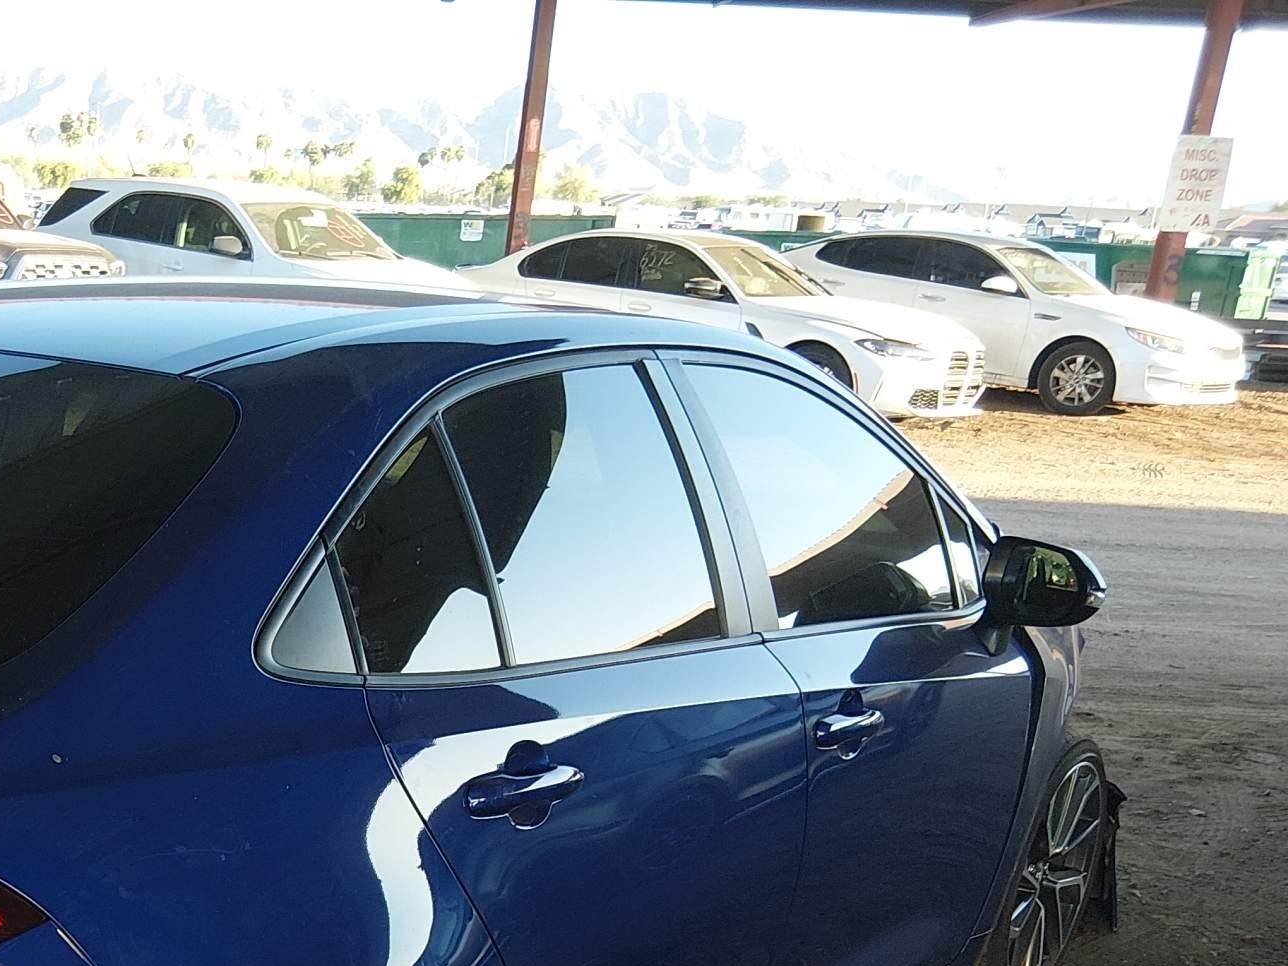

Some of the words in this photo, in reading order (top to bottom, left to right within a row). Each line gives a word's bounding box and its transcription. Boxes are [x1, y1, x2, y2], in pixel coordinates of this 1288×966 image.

[1184, 149, 1218, 162] MISC.
[1180, 168, 1219, 182] DROP
[1176, 188, 1213, 202] ZONE
